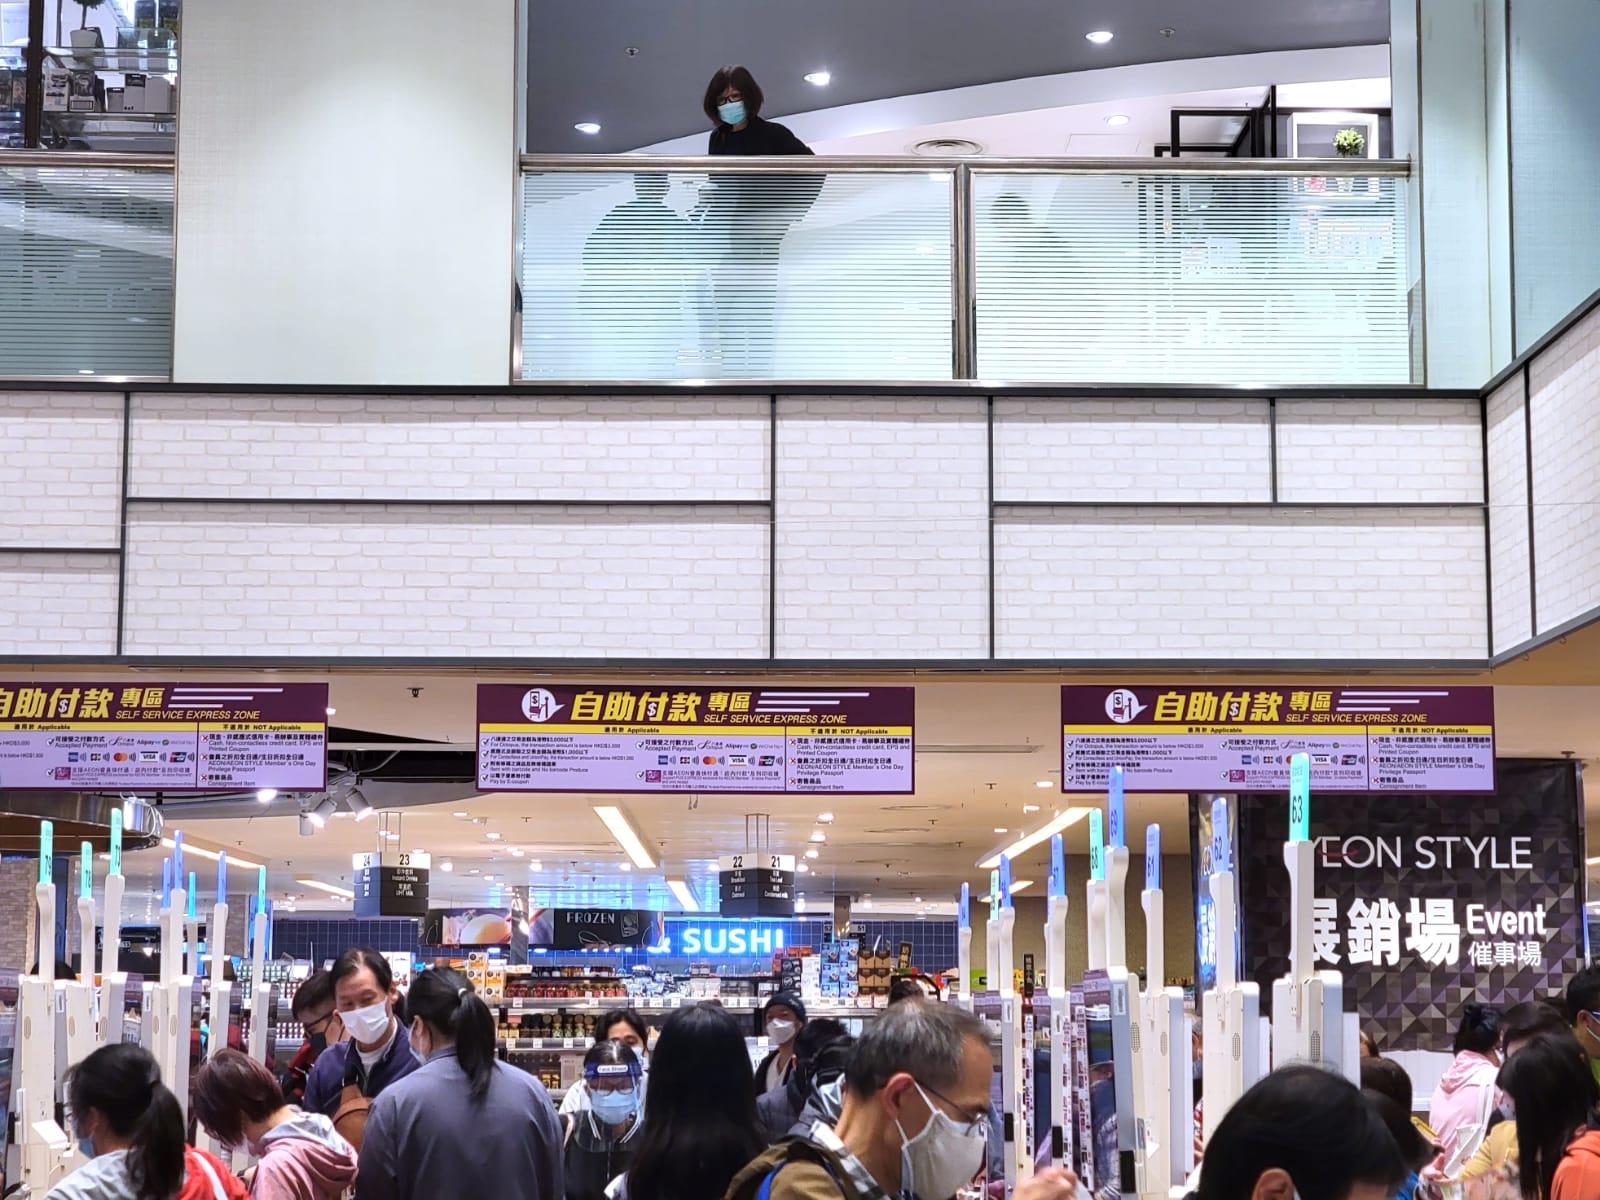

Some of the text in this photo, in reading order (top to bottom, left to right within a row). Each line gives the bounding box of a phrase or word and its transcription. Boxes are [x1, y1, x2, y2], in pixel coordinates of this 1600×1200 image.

[120, 688, 165, 708] 專區
[571, 691, 752, 722] 自助付款 專區
[1154, 691, 1333, 722] 自助付款 專區
[116, 710, 260, 719] SELF SERVICE EXPRESS ZONE
[704, 714, 848, 724] SELF SERVICE EXPRESS ZONE
[1286, 714, 1428, 723] SELF SERVICE EXPRESS ZONE
[1292, 795, 1302, 824] 63
[1214, 836, 1222, 861] 62
[1312, 836, 1532, 869] EON STYLE
[364, 854, 370, 867] 24
[400, 854, 410, 866] 23
[733, 856, 743, 868] 22
[772, 856, 780, 868] 21
[1148, 856, 1154, 878] 61
[566, 912, 615, 924] FROZEN
[1466, 904, 1547, 935] Event
[683, 928, 784, 954] SUSHI
[1468, 941, 1542, 966] 催事場
